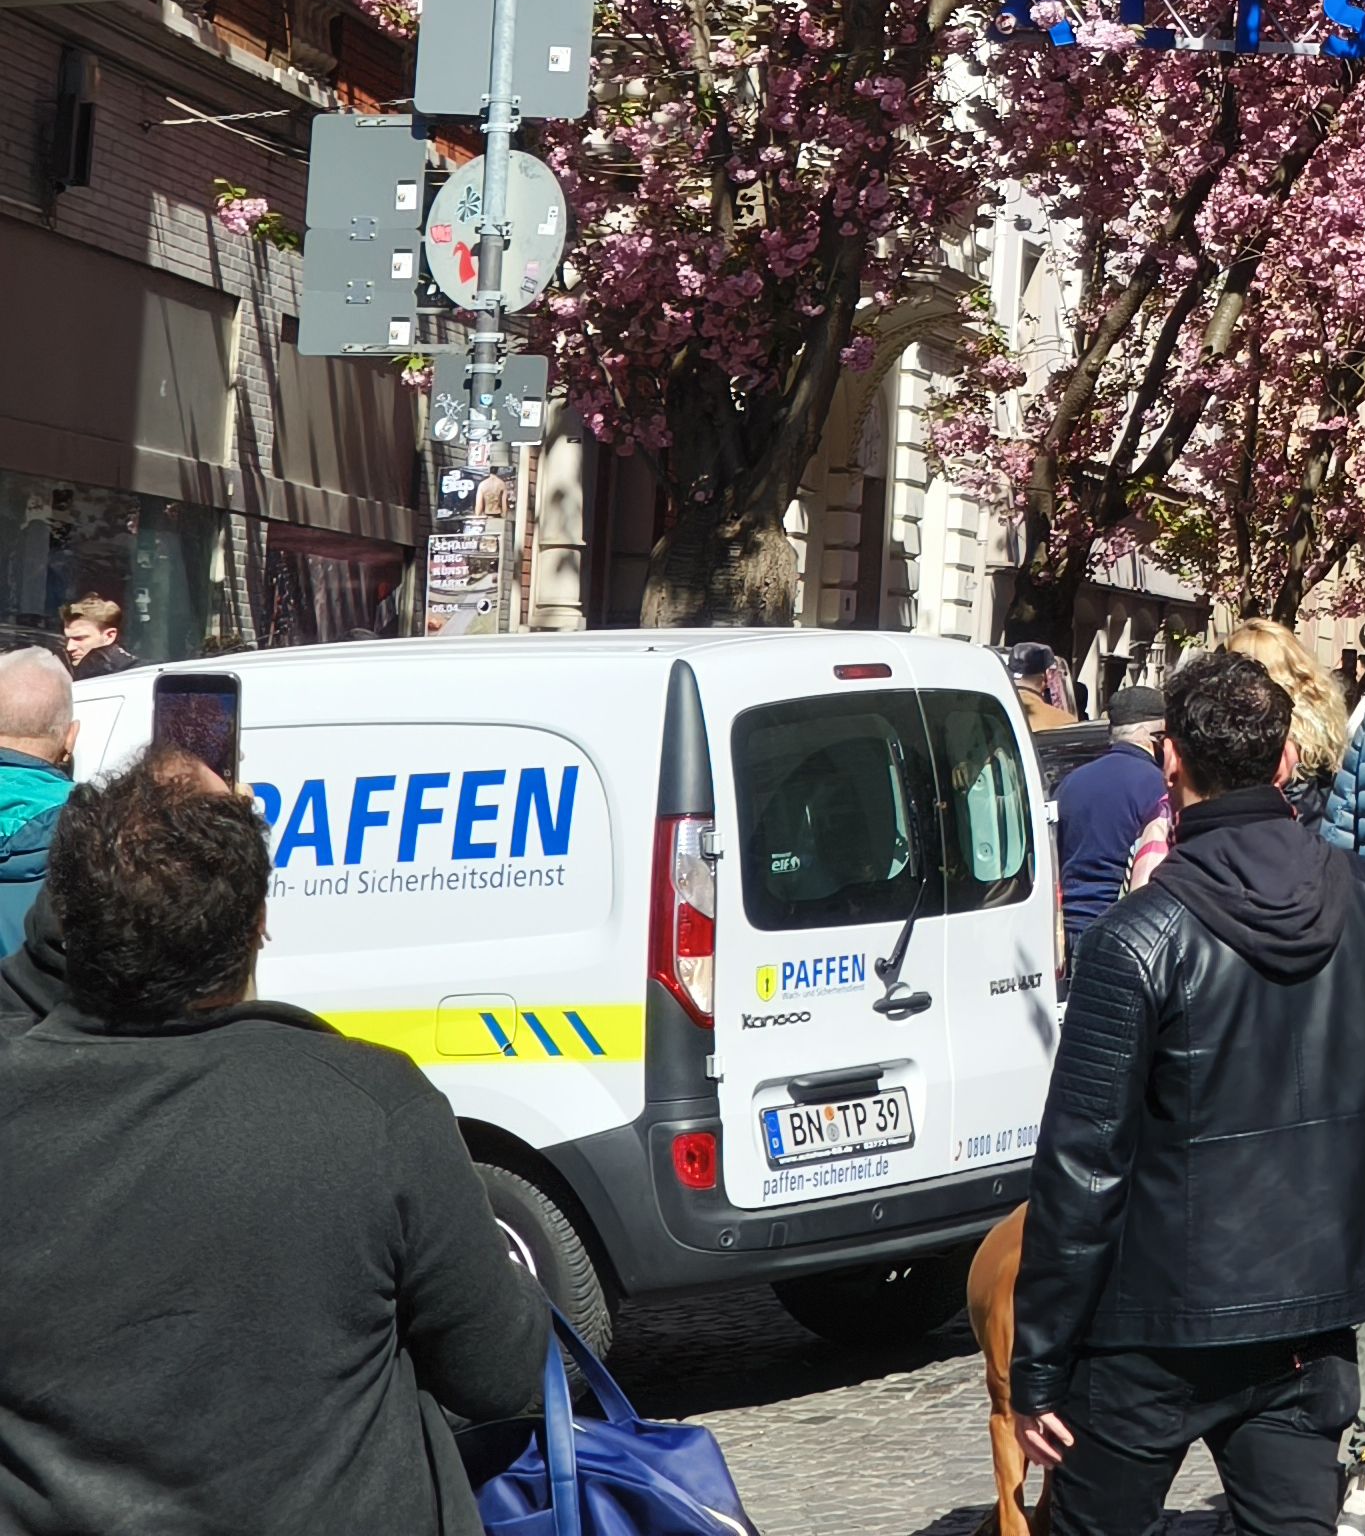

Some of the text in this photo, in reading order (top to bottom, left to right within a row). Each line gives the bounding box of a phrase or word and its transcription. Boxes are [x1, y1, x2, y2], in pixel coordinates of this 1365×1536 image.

[304, 870, 350, 897] und
[357, 863, 566, 895] Sicherheitsdienst
[781, 953, 866, 991] PAFFEN
[742, 1011, 812, 1031] Kangoo
[789, 1097, 900, 1146] BN TP 39
[967, 1134, 992, 1158] 0800
[763, 1155, 889, 1202] paffen-sicherheit.de
